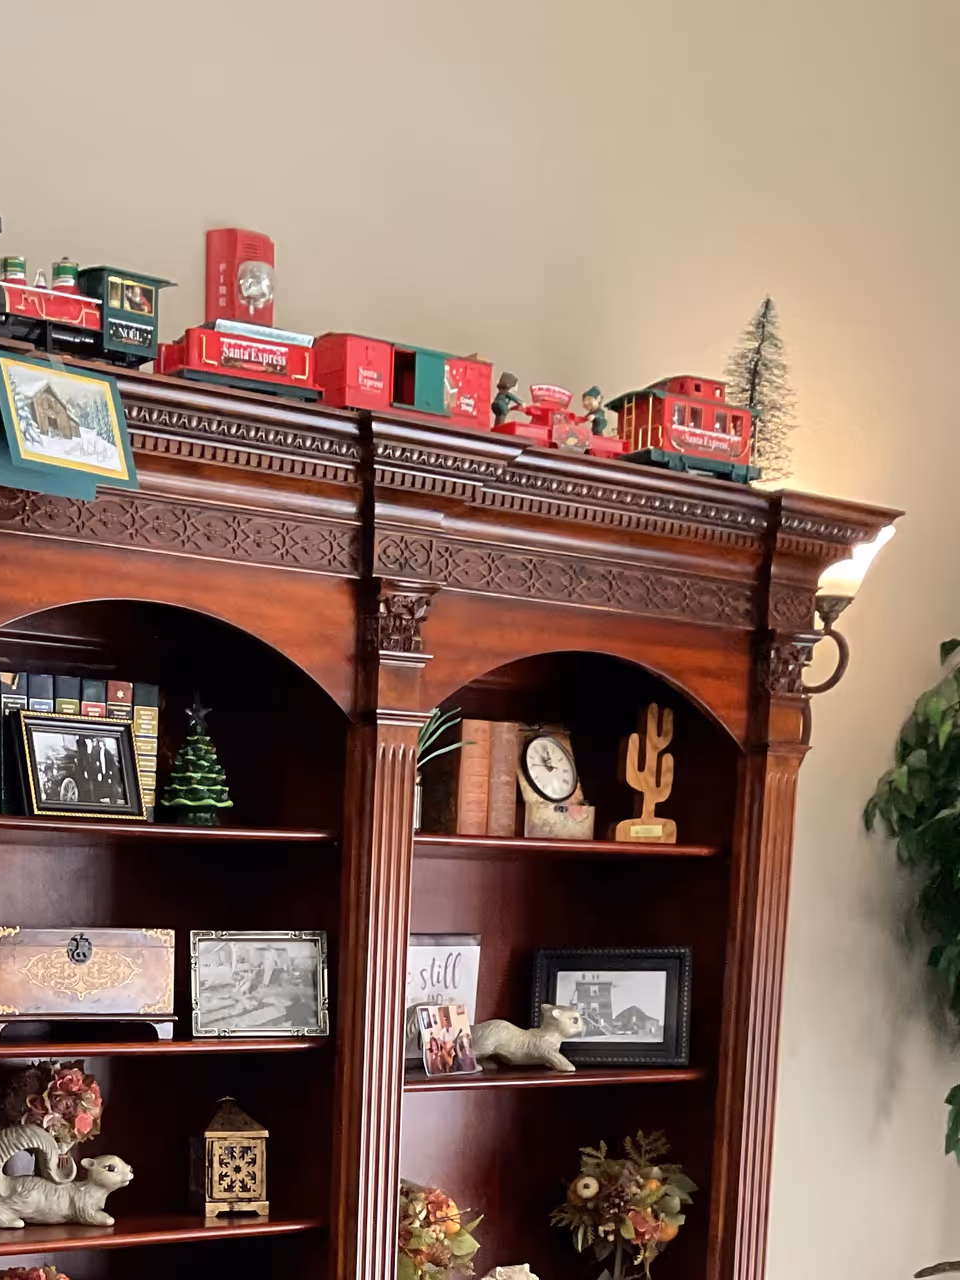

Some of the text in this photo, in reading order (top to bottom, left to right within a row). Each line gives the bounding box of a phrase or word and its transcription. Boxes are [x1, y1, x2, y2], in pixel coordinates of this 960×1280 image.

[222, 342, 287, 367] Santa Express
[358, 366, 378, 379] Santa
[358, 375, 384, 389] Express
[685, 432, 703, 445] Santa
[419, 951, 462, 991] still
